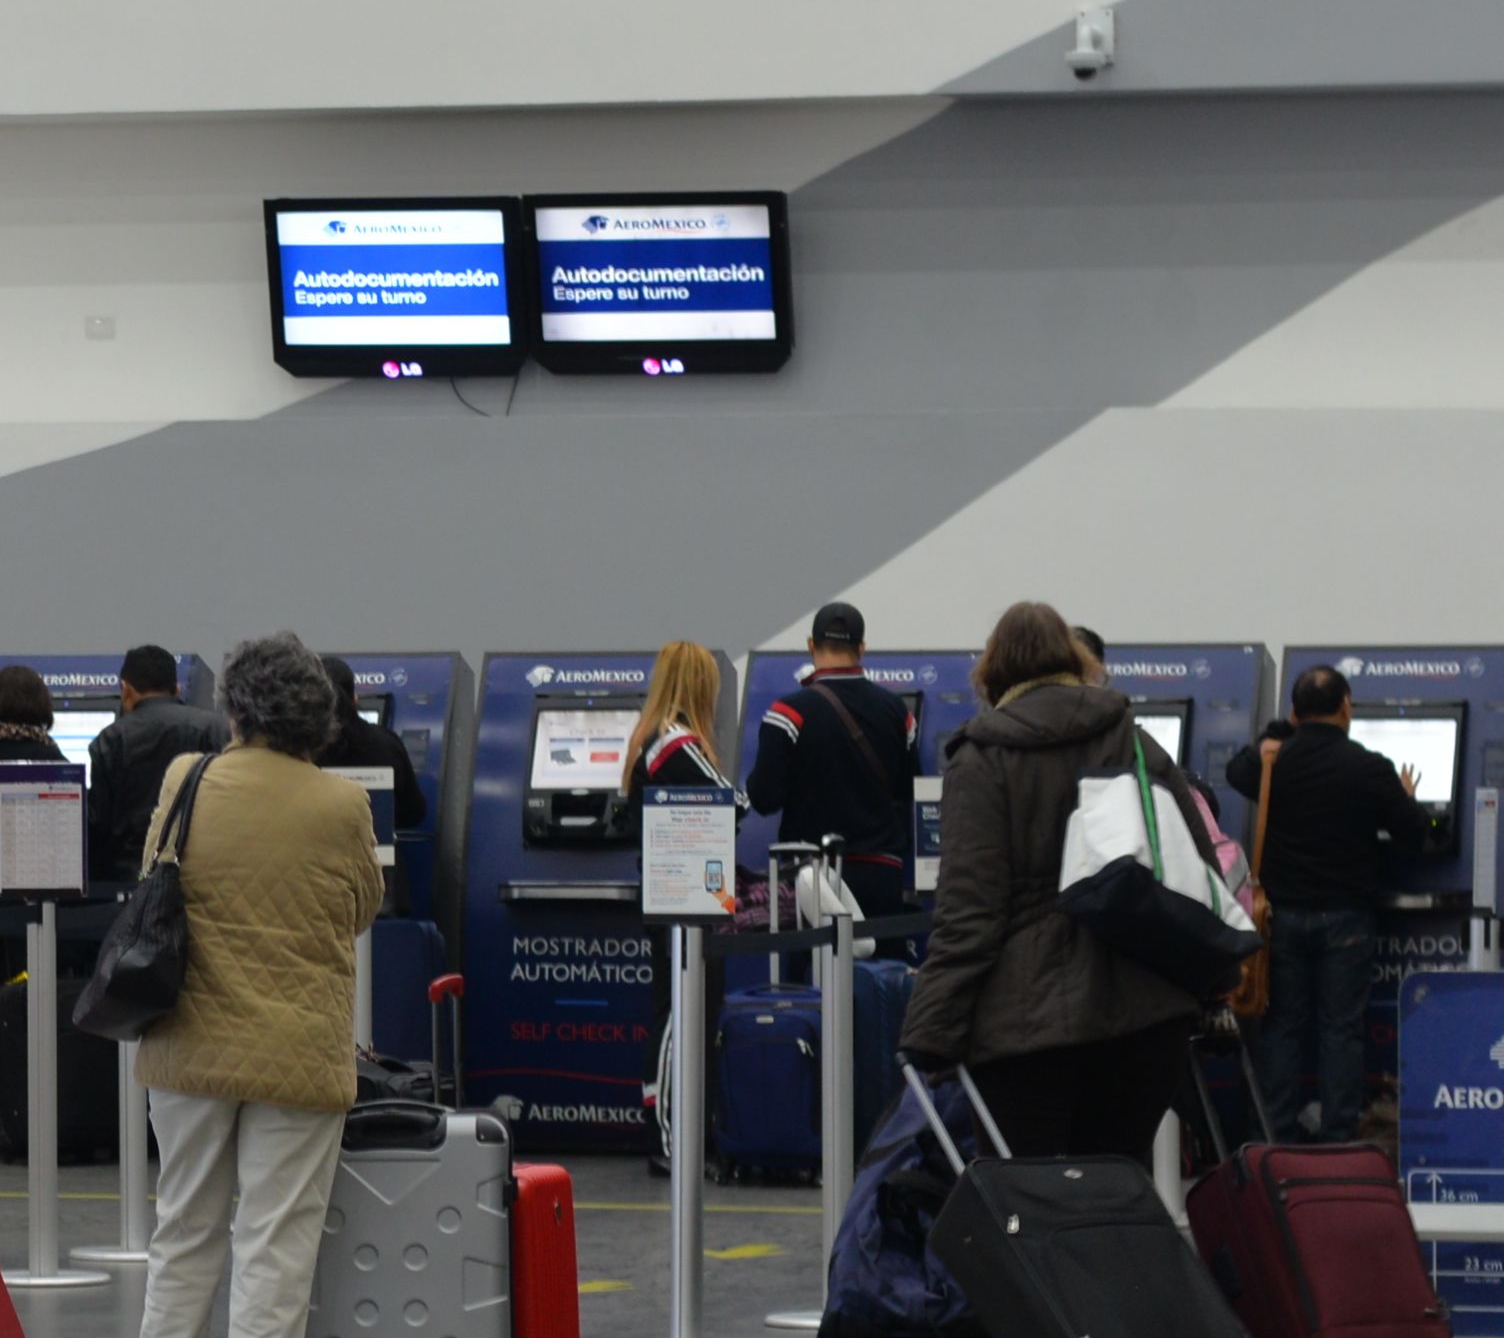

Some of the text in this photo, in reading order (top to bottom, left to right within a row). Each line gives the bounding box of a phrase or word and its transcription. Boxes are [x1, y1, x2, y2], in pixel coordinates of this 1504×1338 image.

[614, 218, 706, 230] AEROMEXICO
[294, 268, 499, 288] Autodocumentación
[552, 262, 765, 283] Autodocumentación
[295, 290, 427, 307] Espere su turno
[553, 285, 689, 303] Espere su turno
[401, 362, 423, 376] LG
[661, 359, 684, 373] LG
[1106, 662, 1187, 676] EROMEXICO
[1366, 661, 1460, 676] AEROMEXICO
[40, 672, 119, 686] EROMEXICO
[556, 669, 645, 683] AEROMEXICO
[513, 936, 652, 957] MOSTRADOR
[511, 961, 653, 983] AUTOMÁTICO
[511, 1023, 551, 1041] SELF
[556, 1023, 625, 1042] CHECK
[1459, 1192, 1479, 1202] cm
[1464, 1257, 1503, 1270] 23 cm
